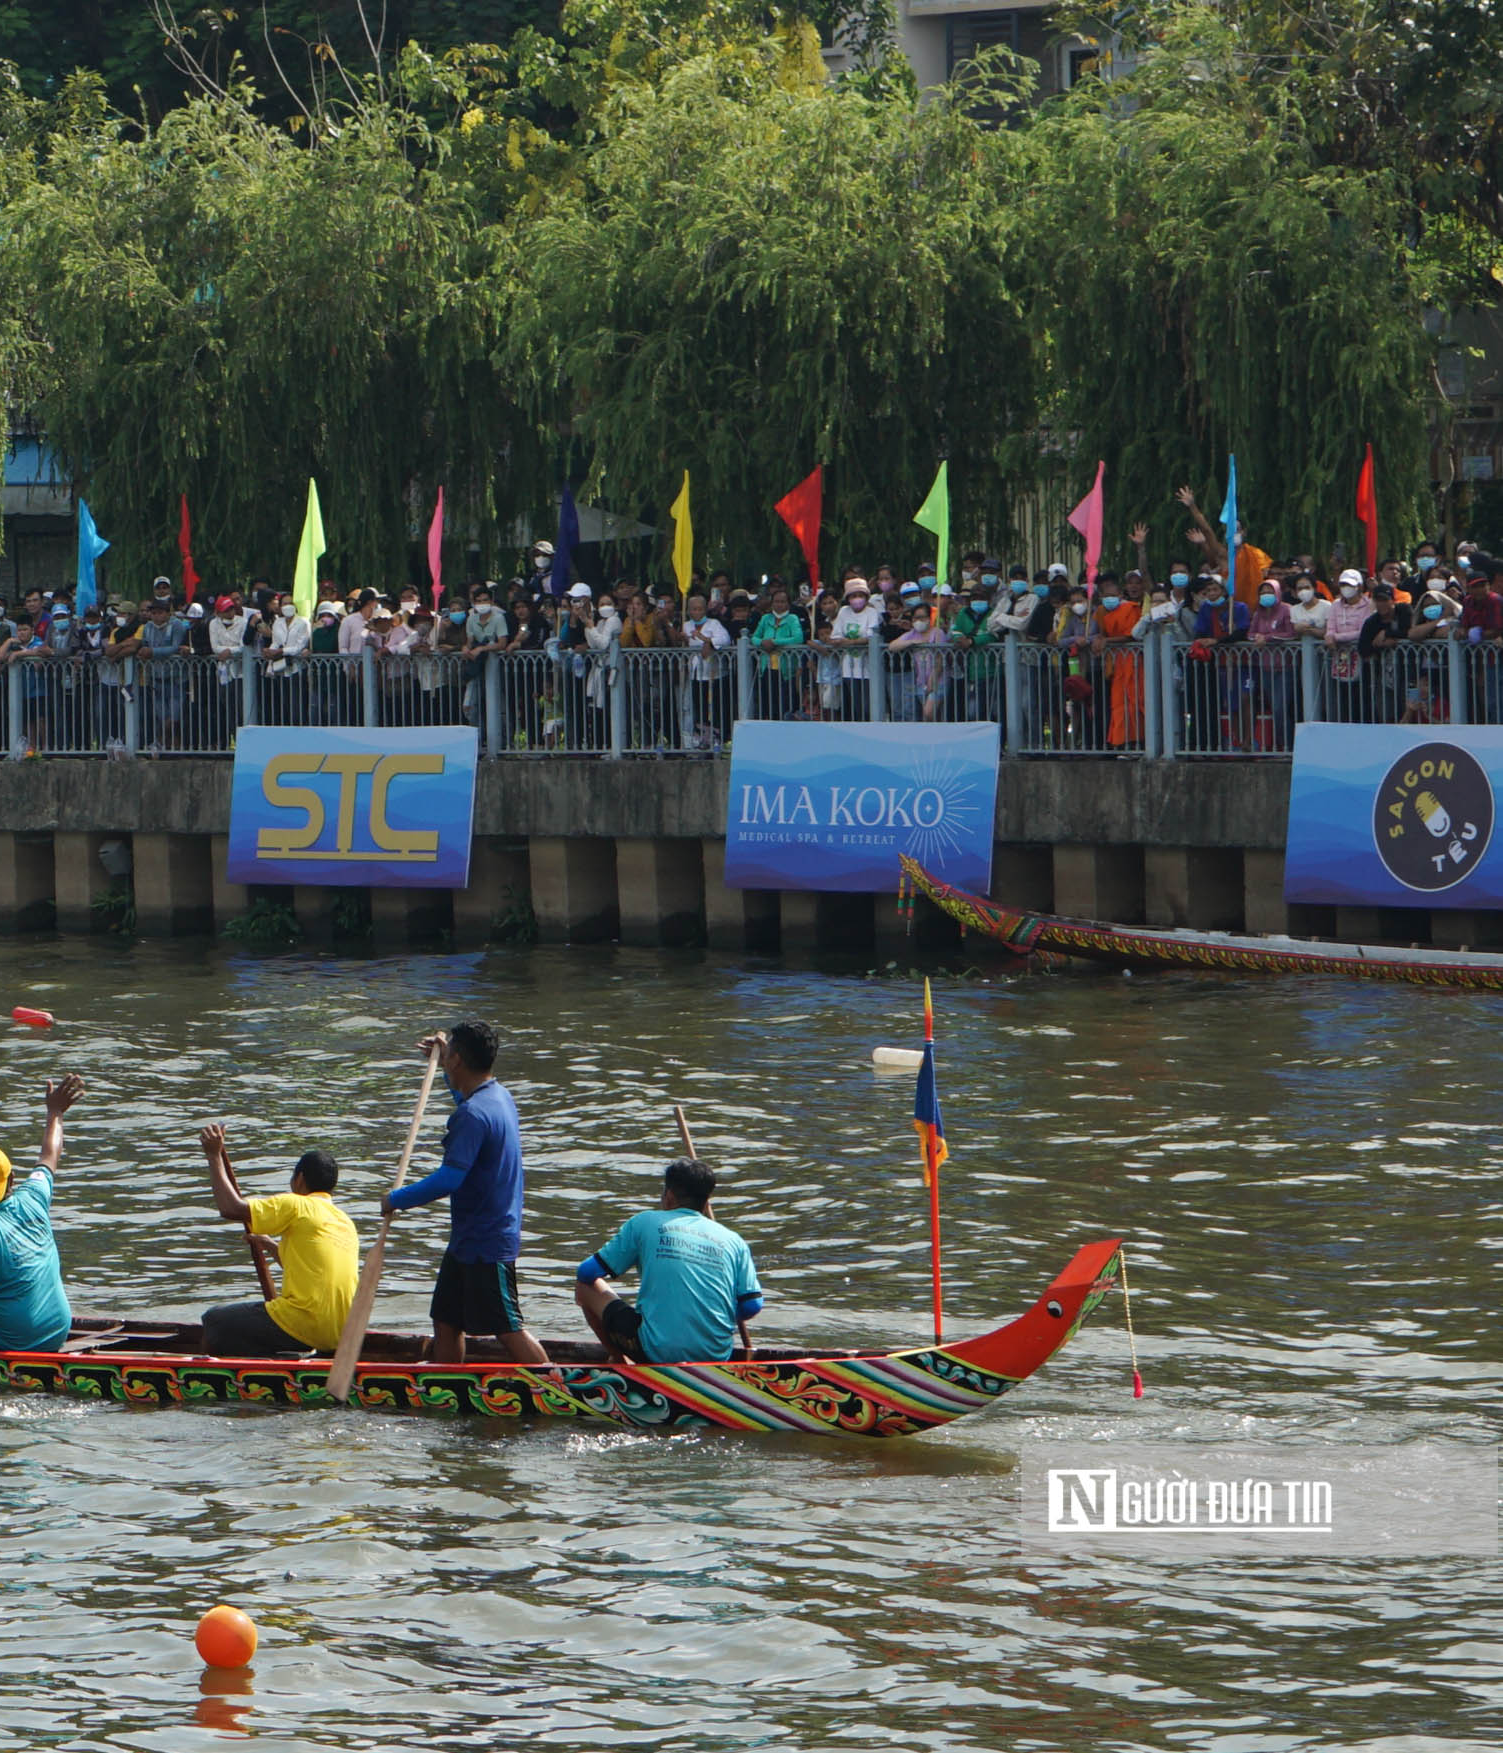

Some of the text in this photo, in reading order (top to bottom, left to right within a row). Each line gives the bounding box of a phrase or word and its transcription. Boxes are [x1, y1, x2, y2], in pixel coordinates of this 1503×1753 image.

[257, 753, 445, 852] STC
[739, 783, 945, 828] IMA KOKO
[1389, 759, 1455, 838] SAIGON
[738, 831, 791, 843] MEDICAL
[797, 832, 818, 844] SPA
[842, 834, 896, 846] RETREAT
